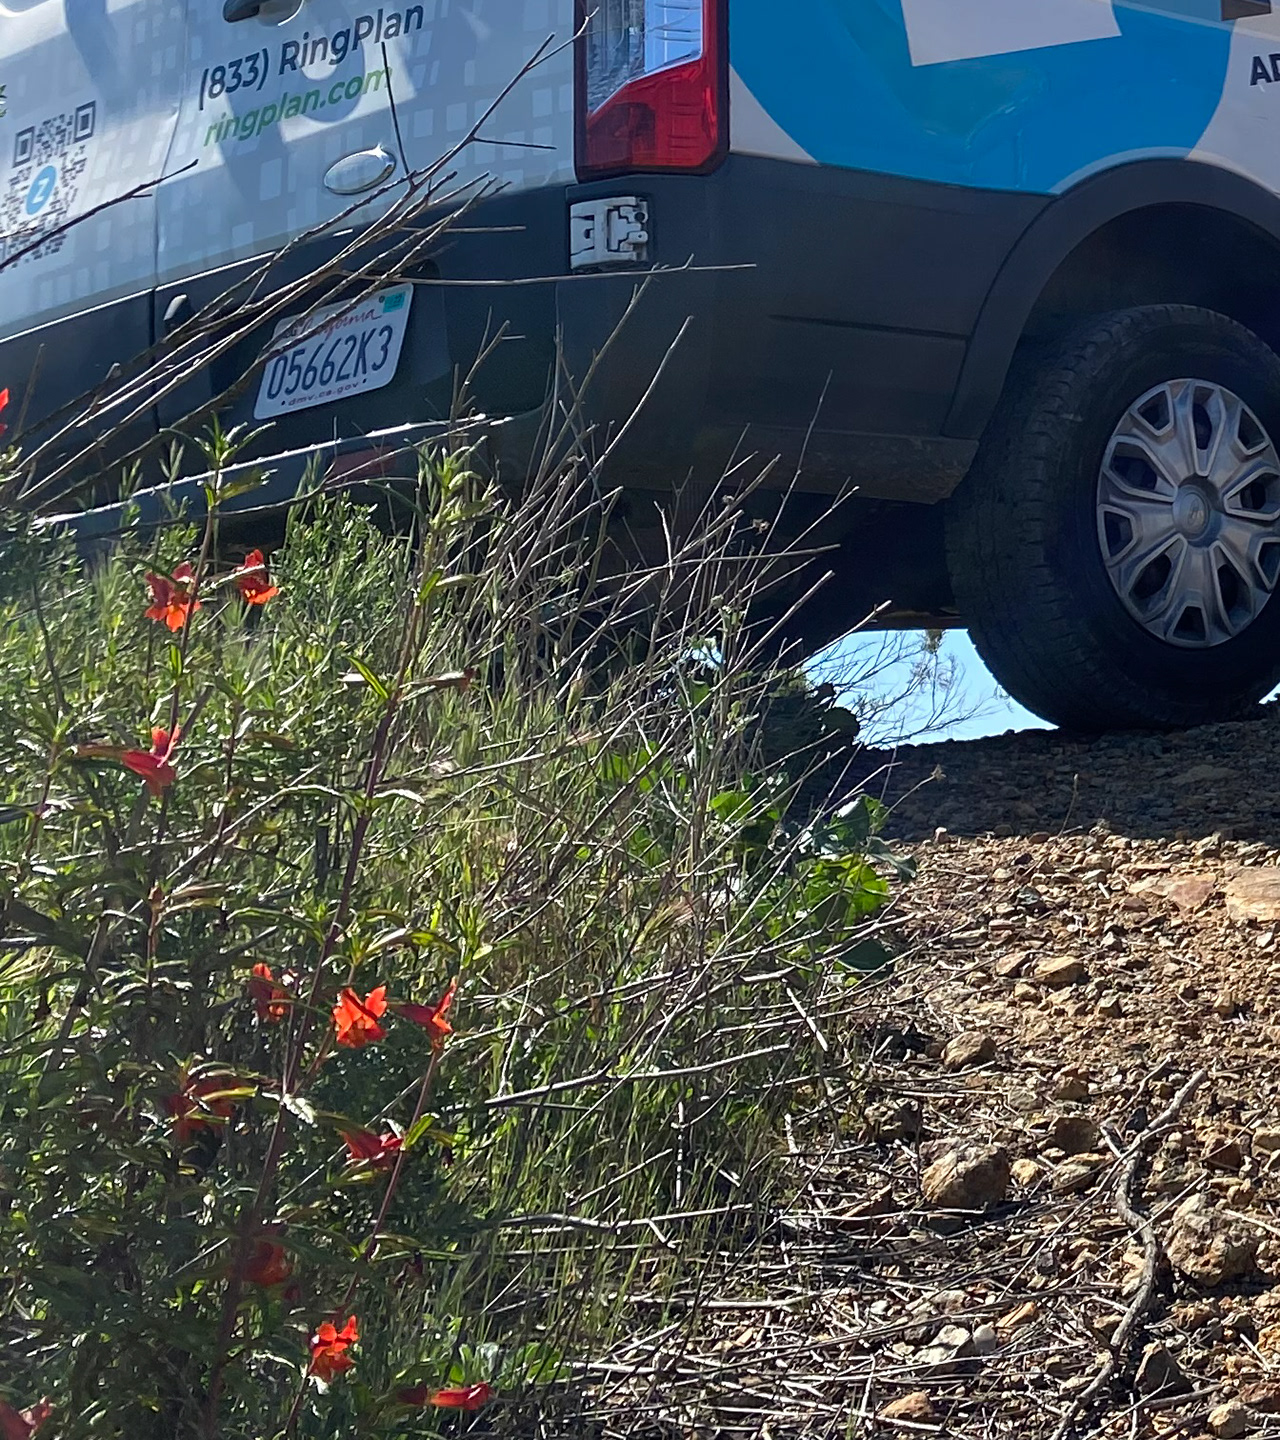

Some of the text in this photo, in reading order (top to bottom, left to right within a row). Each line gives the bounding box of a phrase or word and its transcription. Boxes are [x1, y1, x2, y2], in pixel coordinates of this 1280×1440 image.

[199, 4, 424, 111] (833) RingPlan
[203, 66, 393, 148] ringplan.com
[266, 324, 394, 400] 05662K3
[288, 382, 359, 406] dmv.ca.gov
